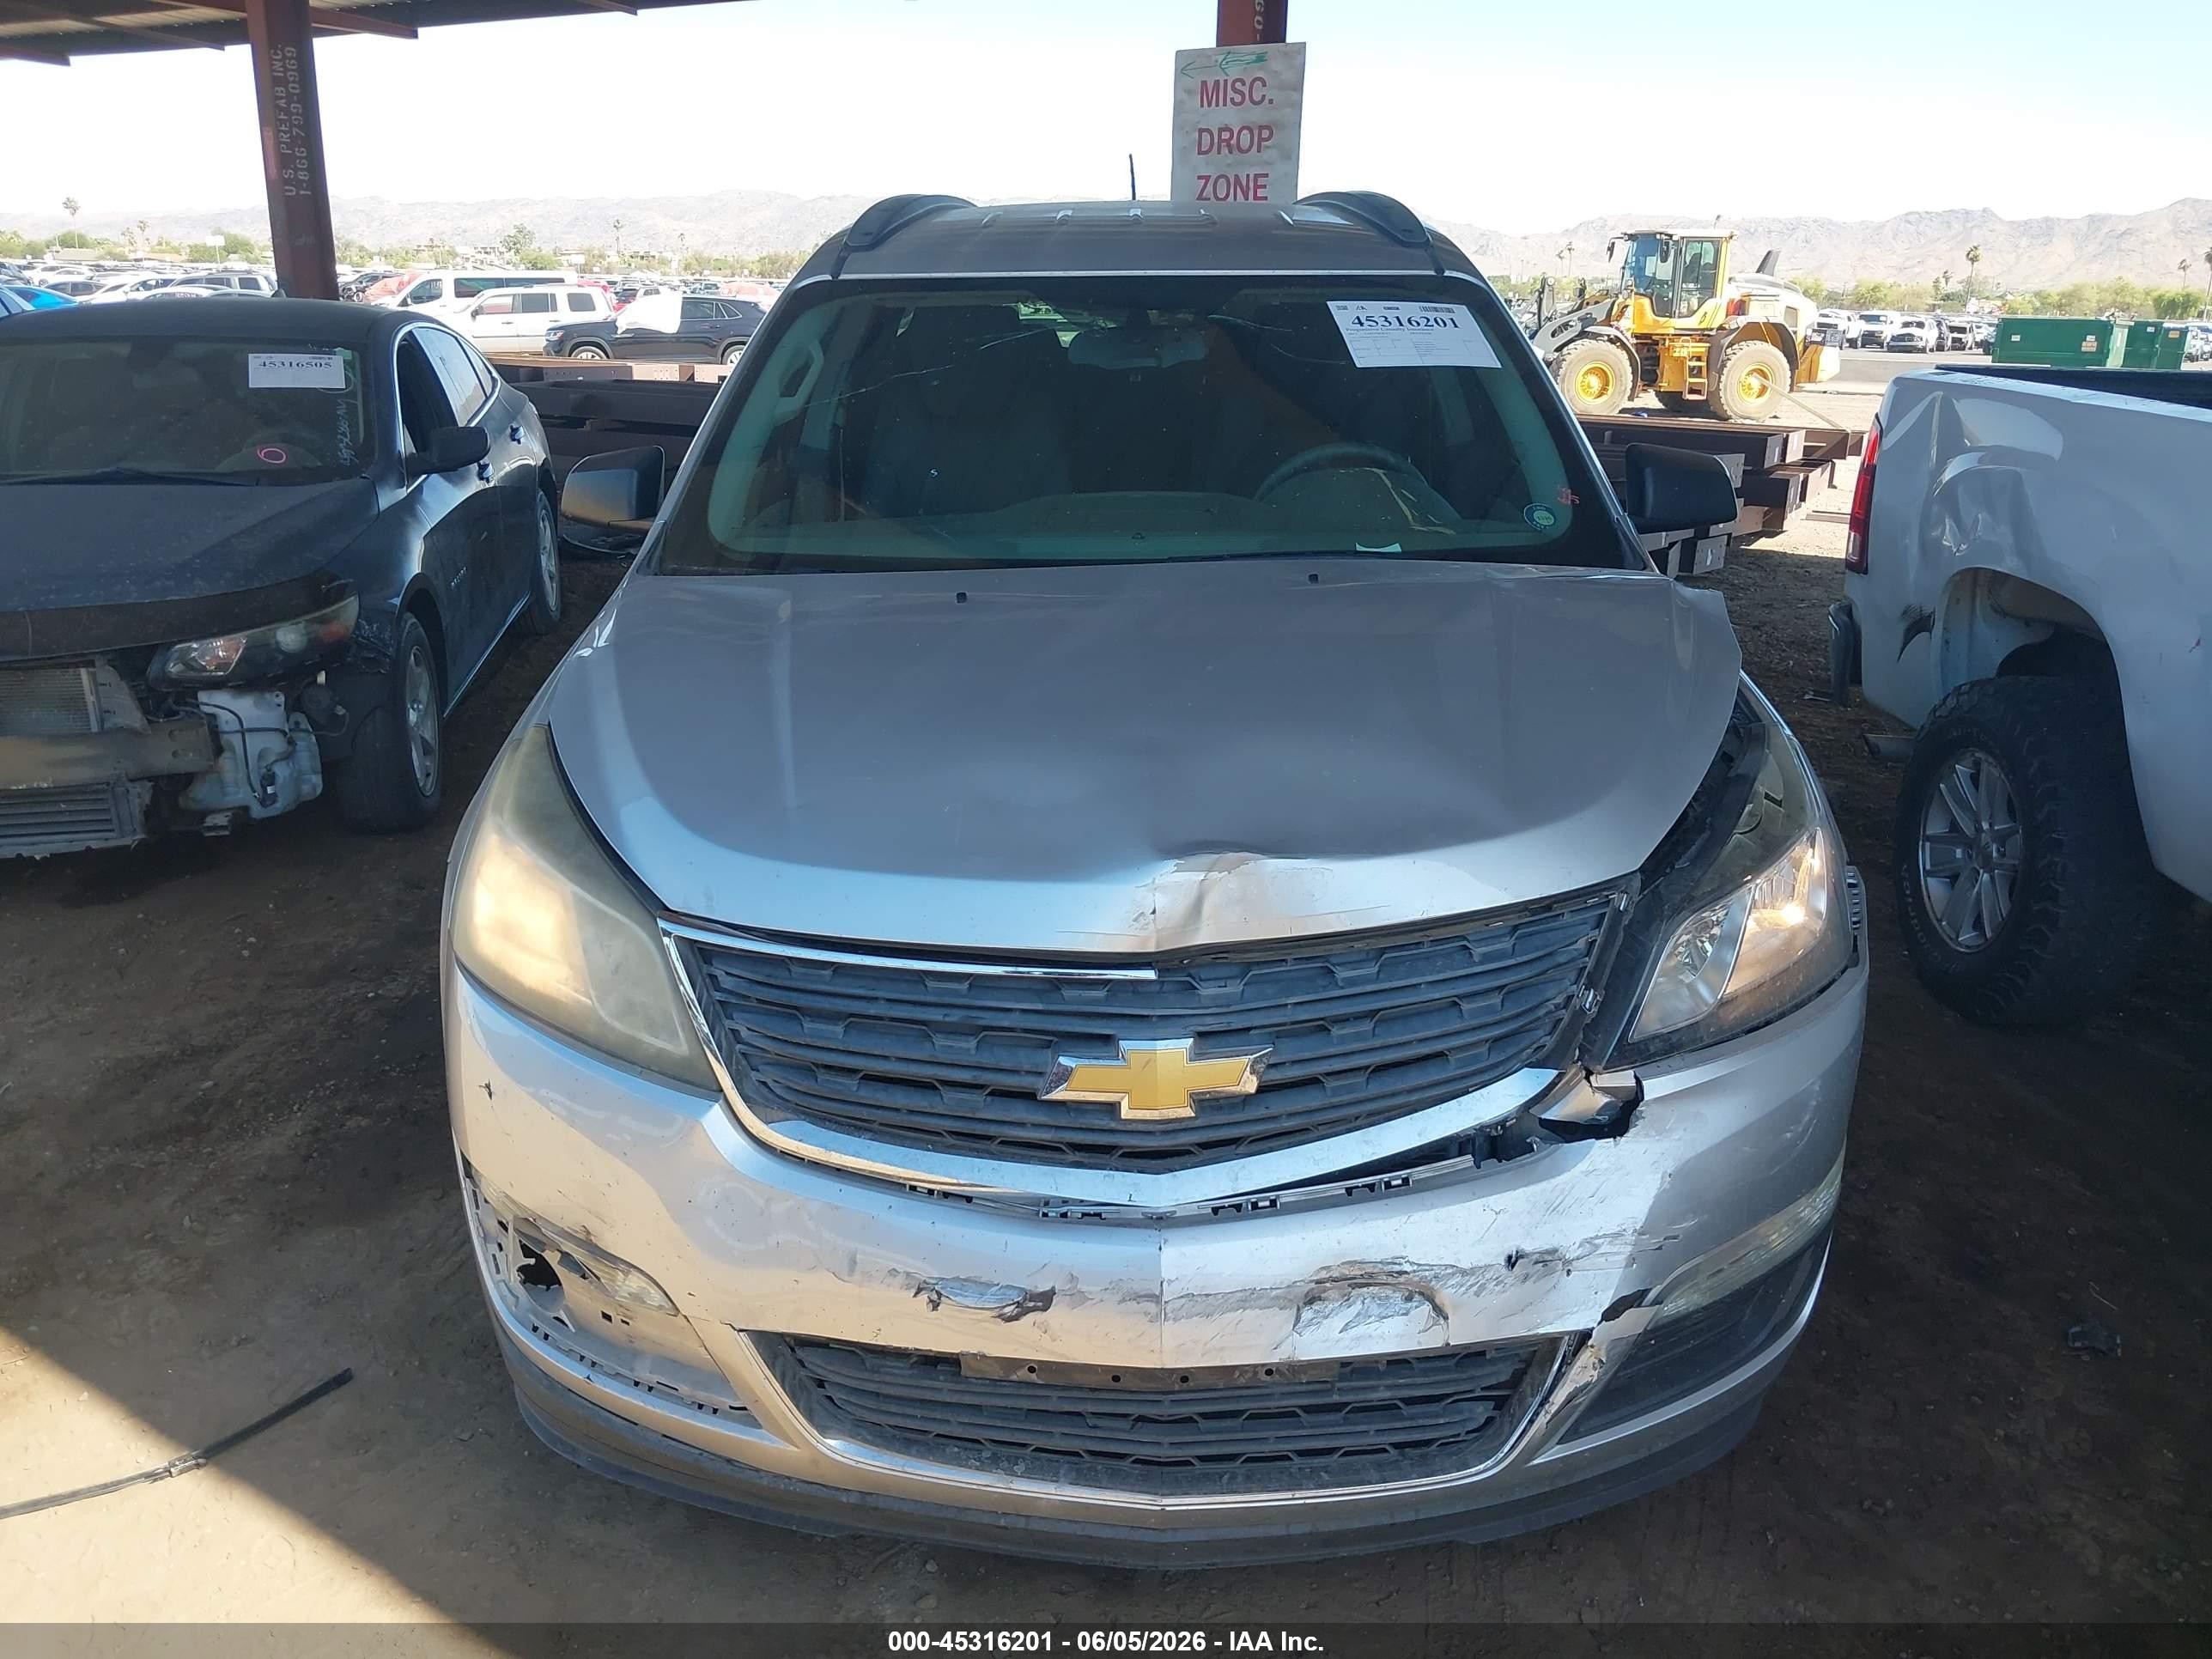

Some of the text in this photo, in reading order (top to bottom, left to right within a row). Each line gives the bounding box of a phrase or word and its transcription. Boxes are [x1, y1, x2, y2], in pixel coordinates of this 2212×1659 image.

[1199, 76, 1274, 108] MISC.
[270, 44, 297, 197] U.S. PREFAB INC.
[1196, 125, 1274, 155] DROP
[1195, 173, 1269, 202] ZONE
[1351, 314, 1461, 329] 45316201
[258, 360, 332, 369] 45316505
